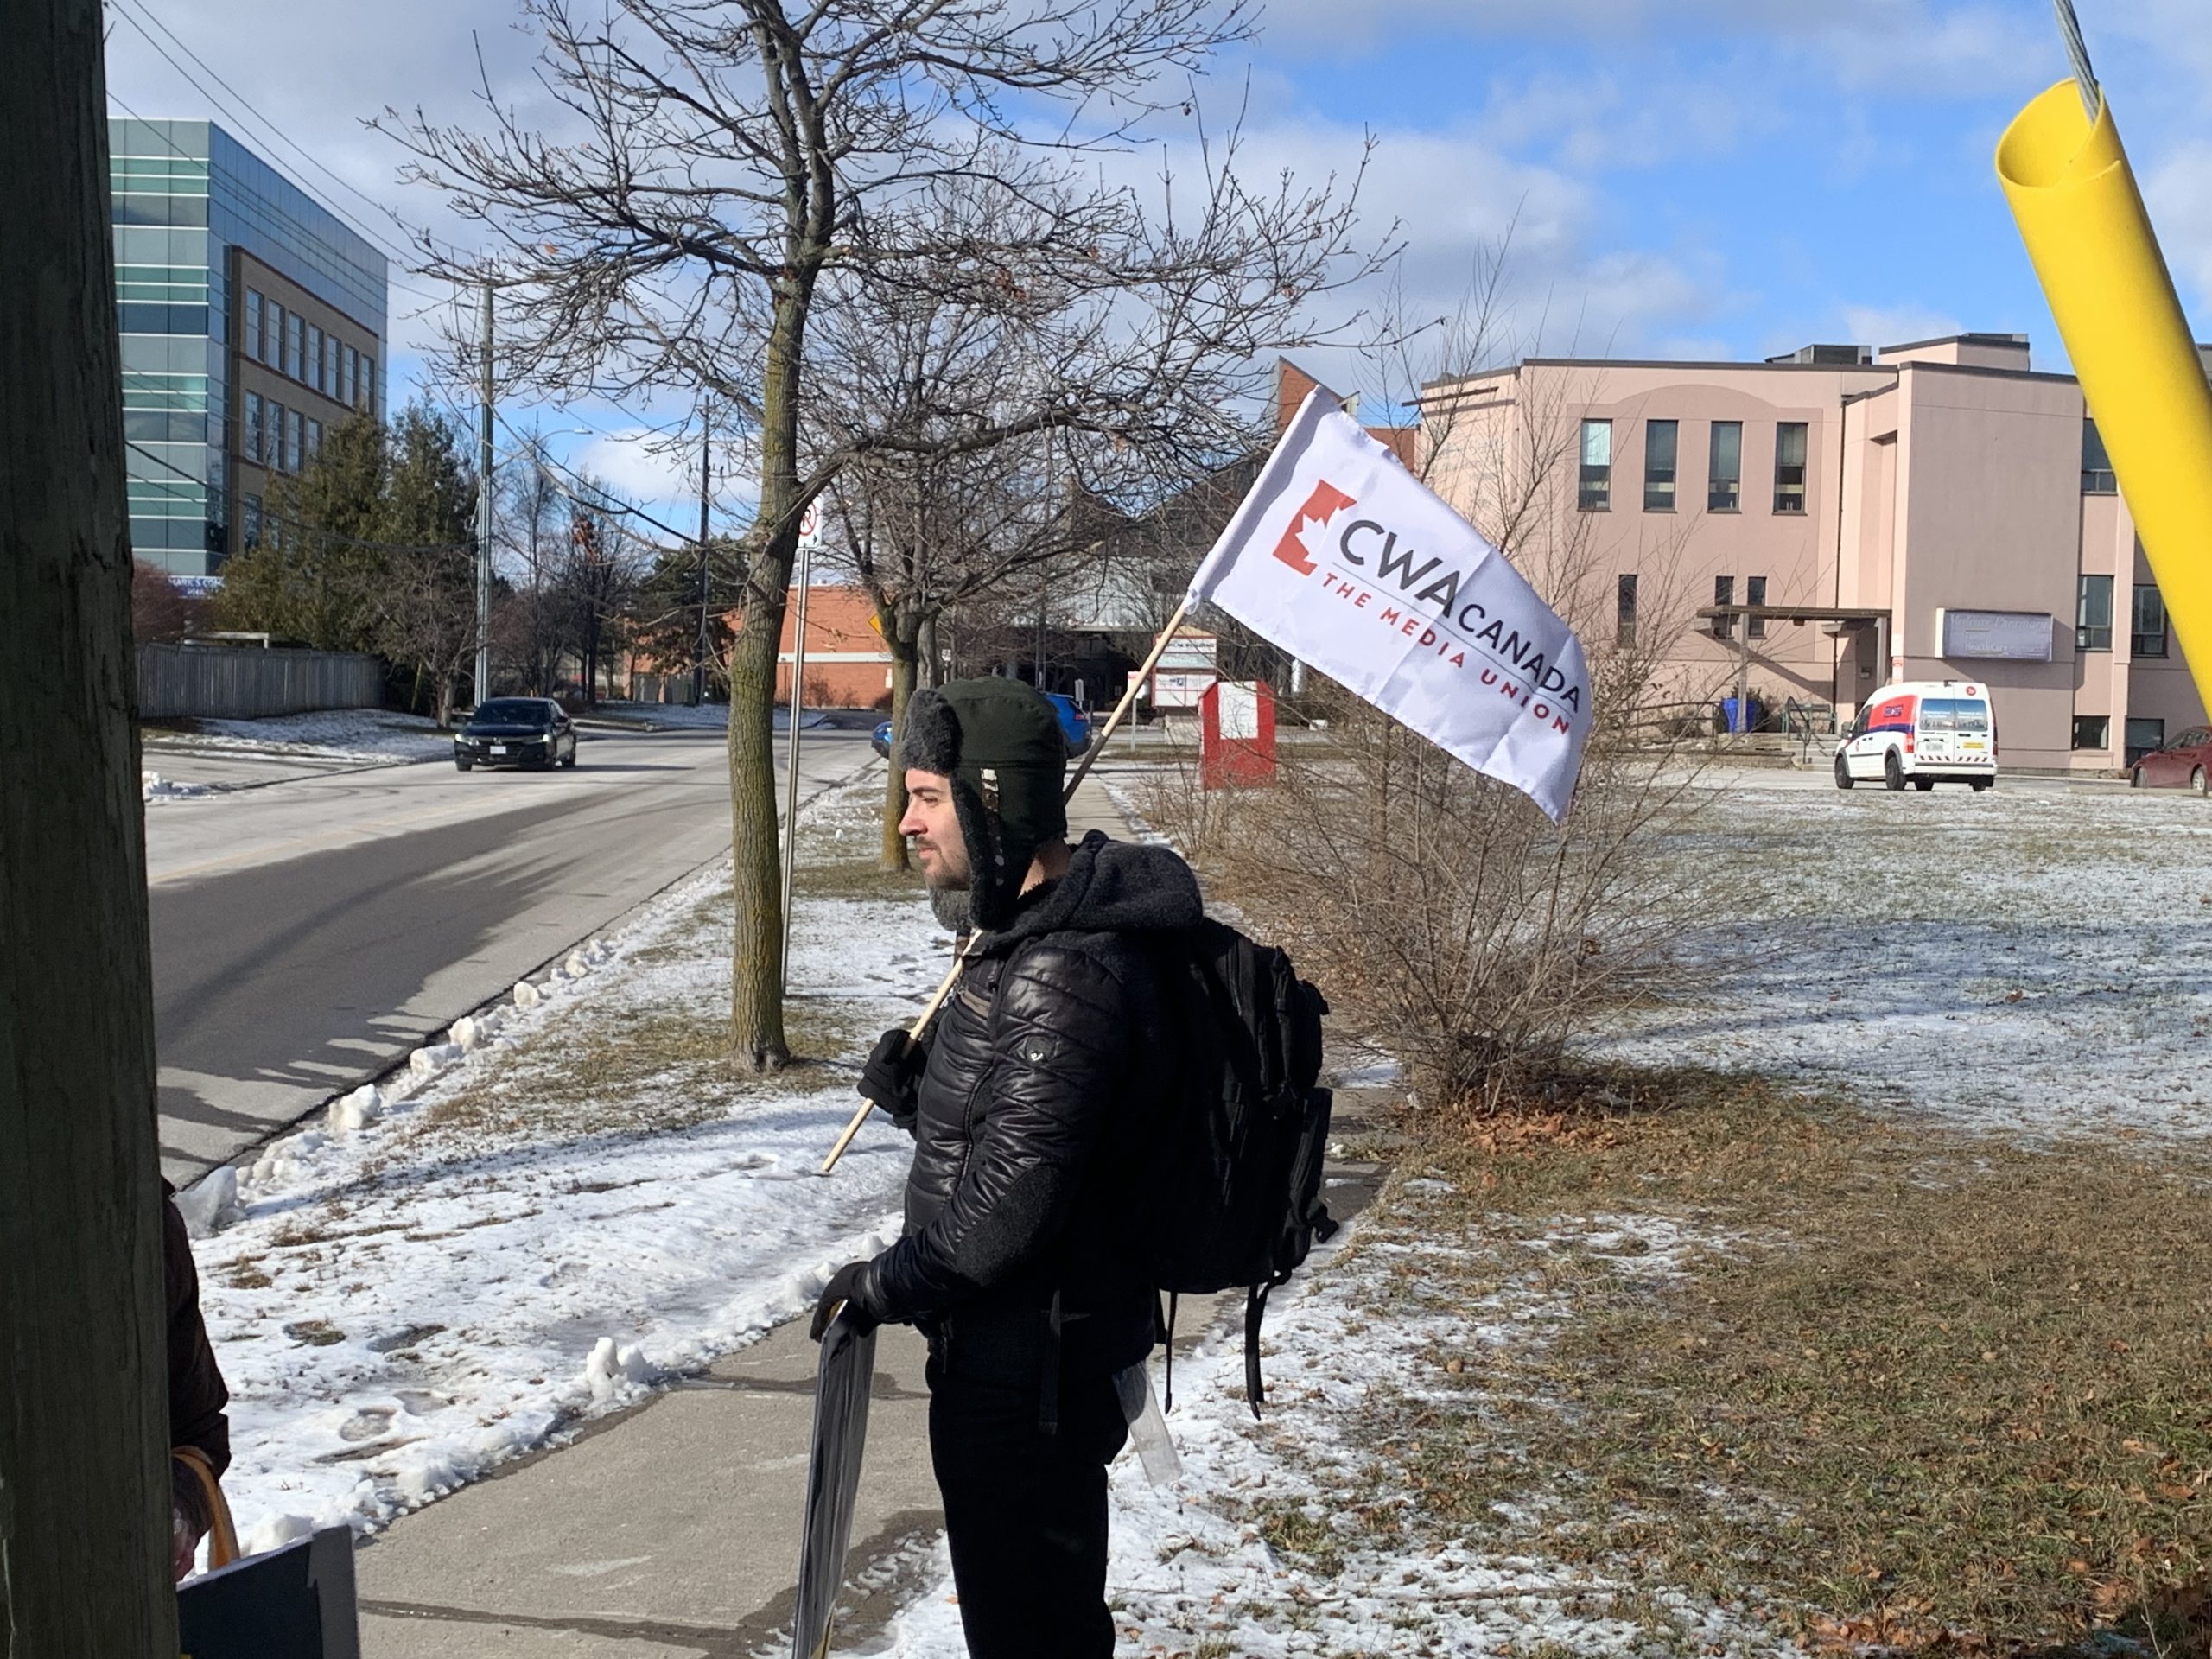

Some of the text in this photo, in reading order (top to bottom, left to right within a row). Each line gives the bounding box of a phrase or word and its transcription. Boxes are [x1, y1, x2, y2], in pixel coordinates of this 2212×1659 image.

[1322, 572, 1570, 734] THE MEDIA UNION
[1339, 519, 1580, 714] CWA CANADA
[1994, 615, 2048, 631] Pharmacy
